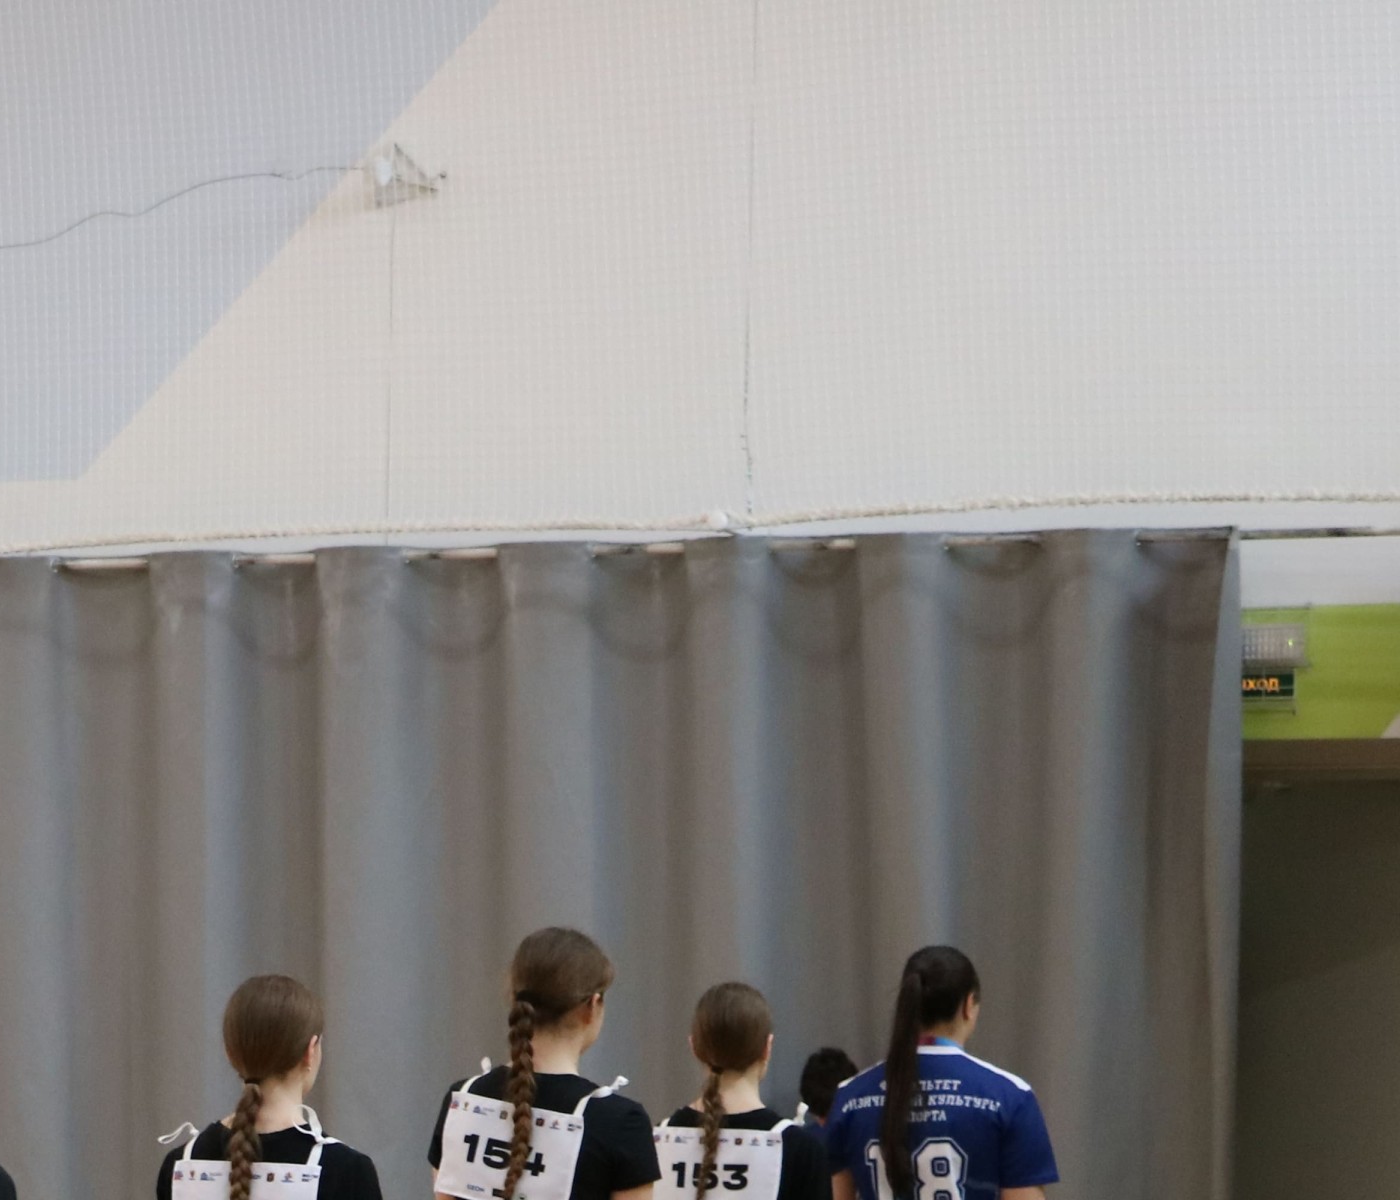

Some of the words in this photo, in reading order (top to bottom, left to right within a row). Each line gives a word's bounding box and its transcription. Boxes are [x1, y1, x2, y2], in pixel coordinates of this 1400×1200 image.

[1242, 678, 1280, 693] ХОД
[928, 1094, 1001, 1112] КУЛЬТУРЫ
[463, 1133, 546, 1177] 154
[672, 1161, 749, 1190] 153
